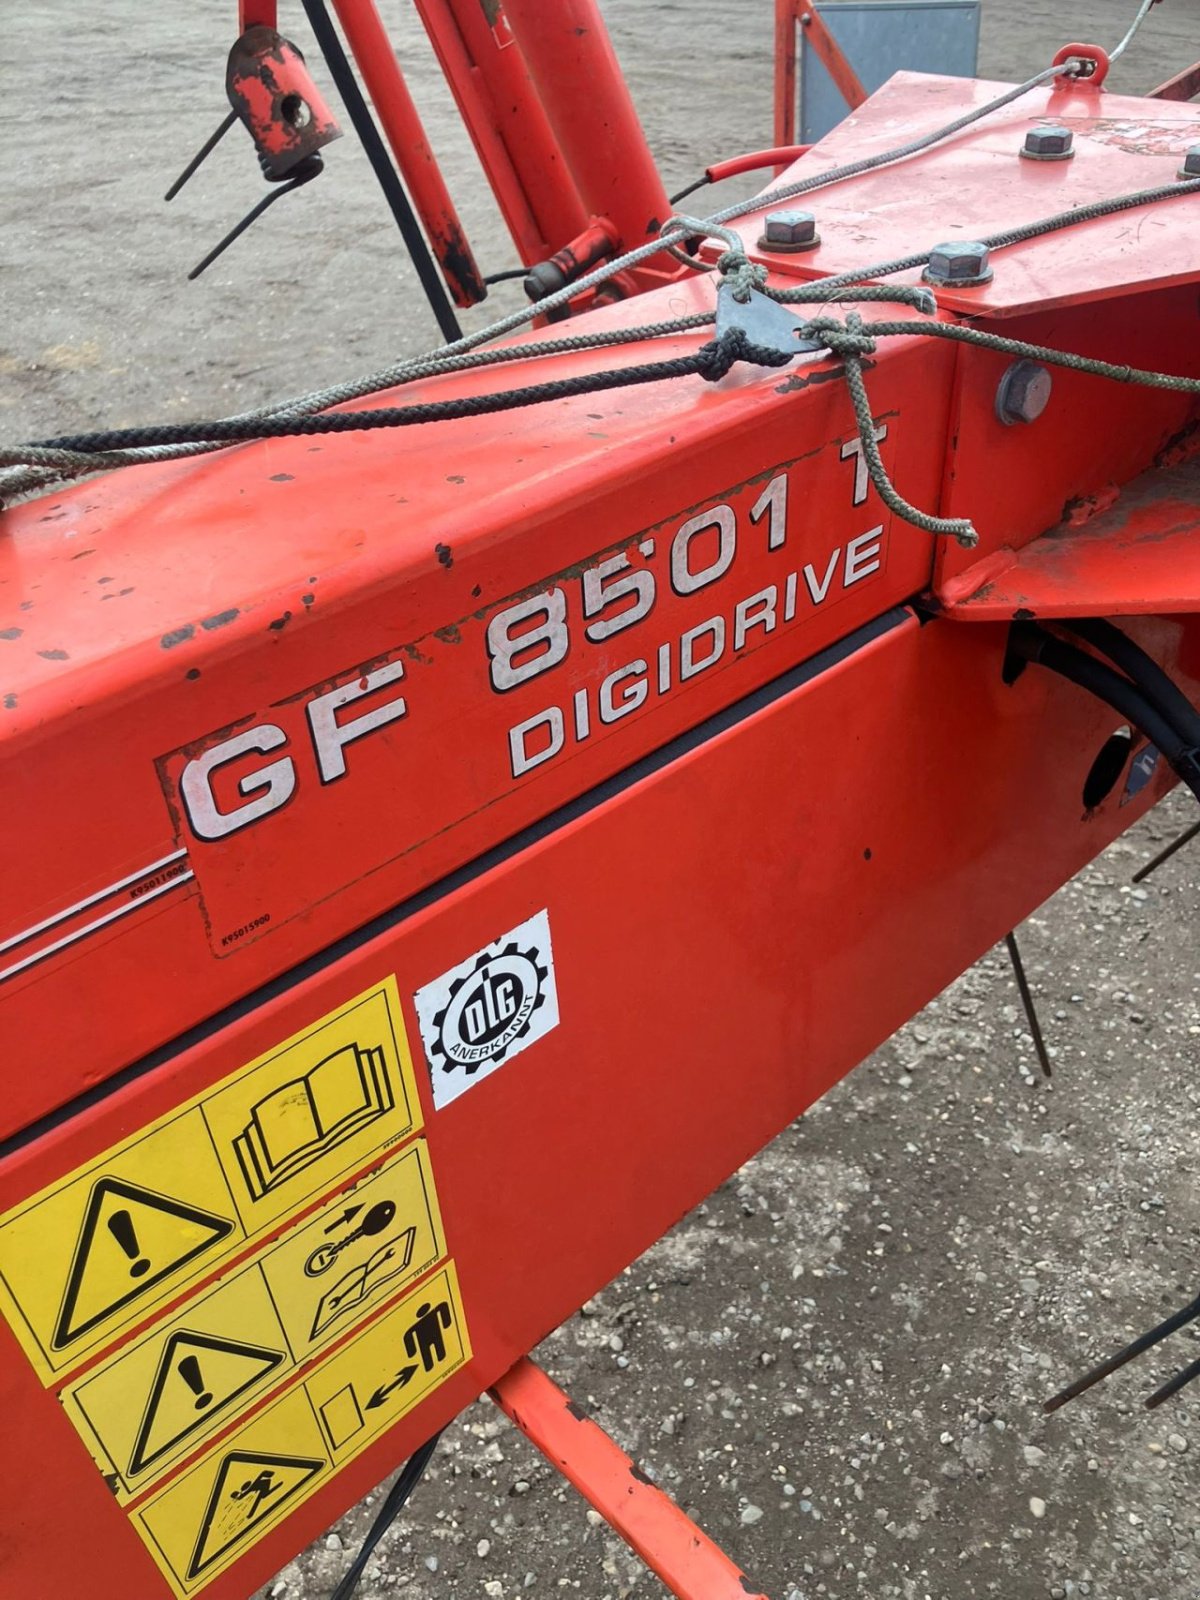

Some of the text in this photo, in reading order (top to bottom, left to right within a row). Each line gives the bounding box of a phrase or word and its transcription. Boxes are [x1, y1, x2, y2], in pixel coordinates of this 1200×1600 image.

[179, 424, 888, 842] GF 8501 T
[508, 524, 884, 779] DIGIDRIVE
[450, 994, 534, 1060] ANERKANNT
